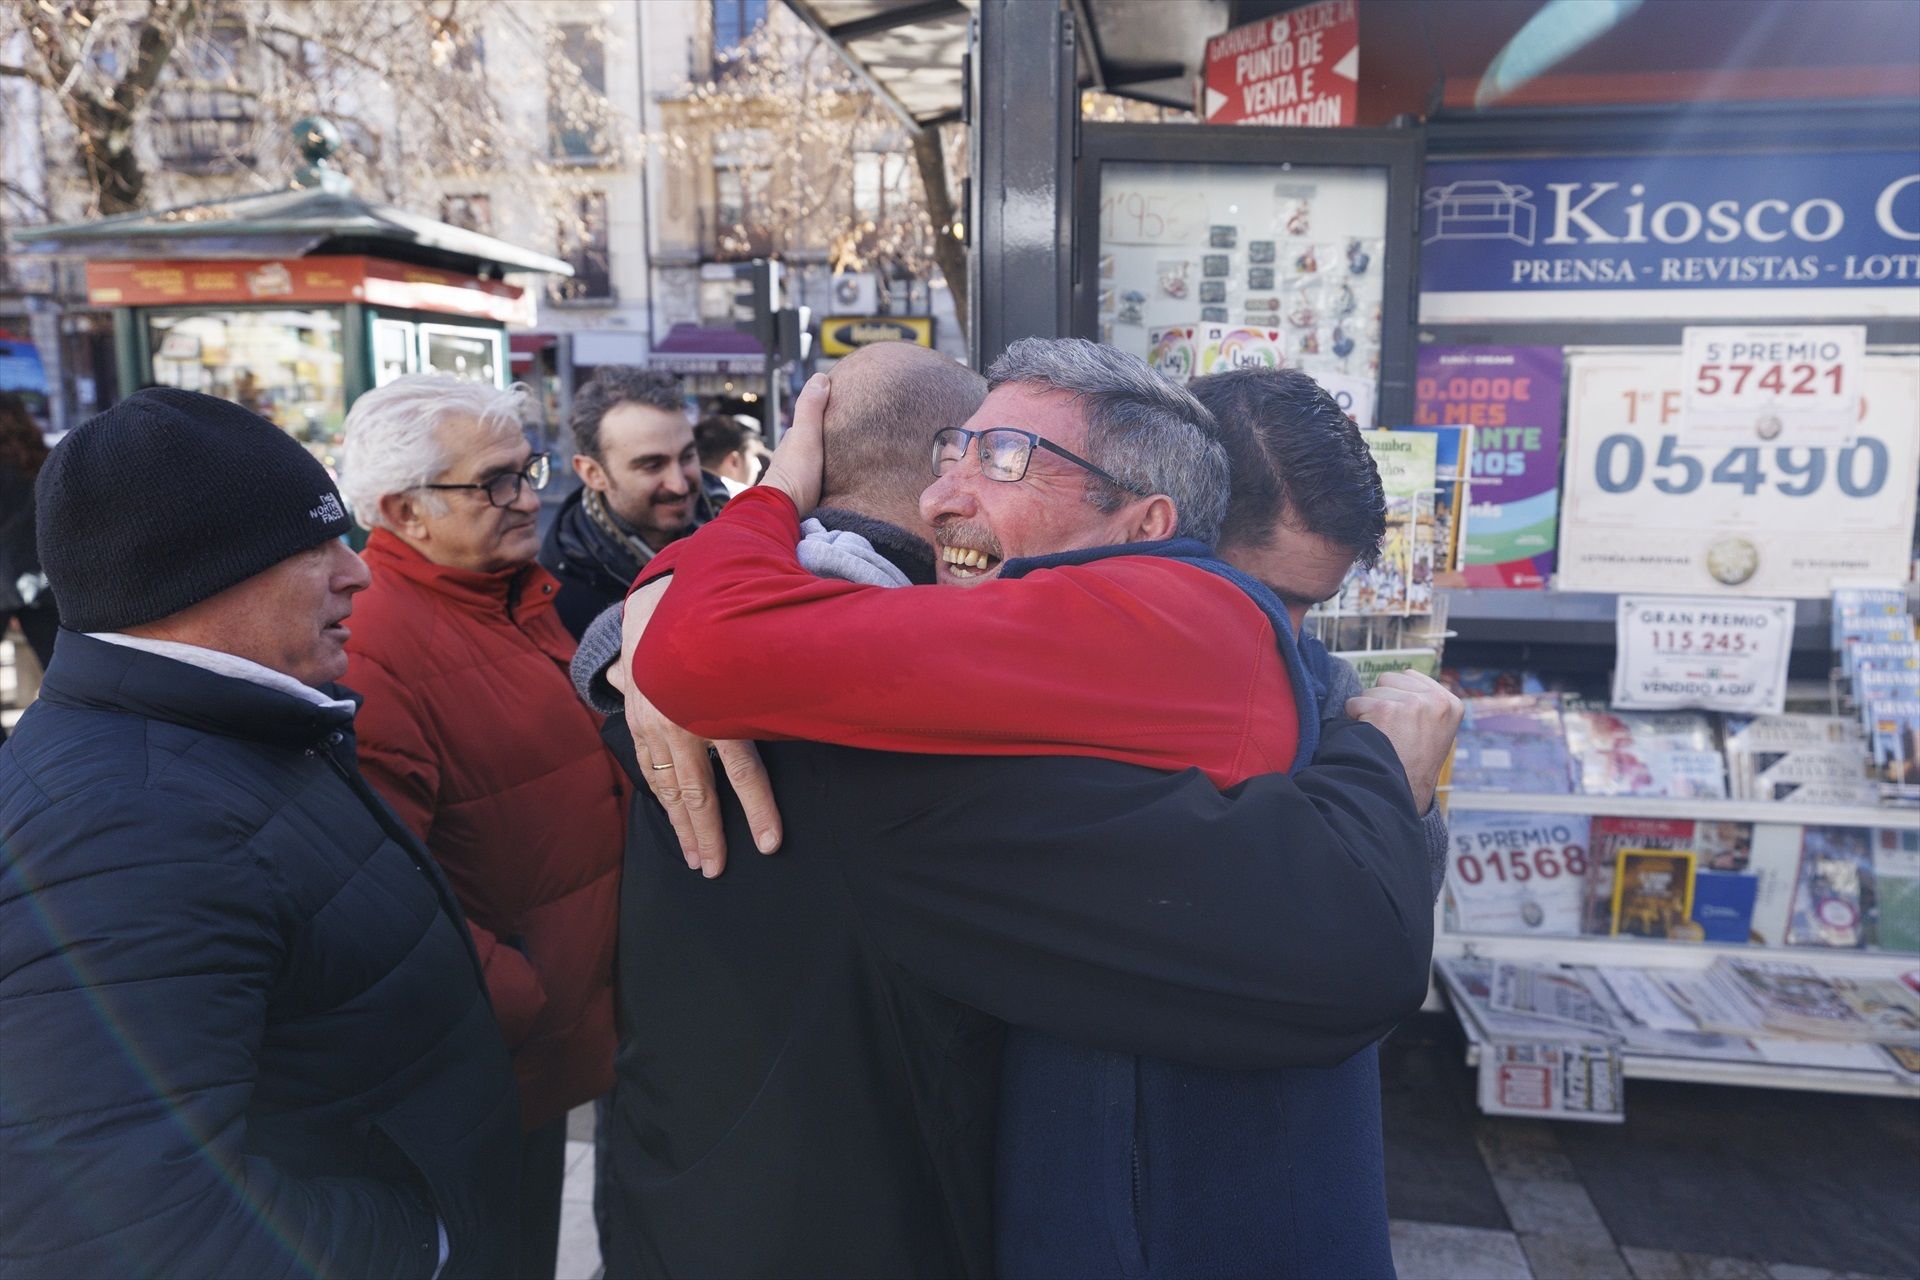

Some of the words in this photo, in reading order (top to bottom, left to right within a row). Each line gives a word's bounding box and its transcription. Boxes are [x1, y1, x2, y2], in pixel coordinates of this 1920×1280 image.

[1236, 41, 1294, 85] PUNTO
[1298, 31, 1323, 68] DE
[1243, 73, 1298, 114] VENTA
[1301, 68, 1315, 100] E
[1236, 92, 1341, 125] MACIÓN
[1543, 182, 1845, 245] Kiosco
[1511, 258, 1636, 284] PRENSA
[1660, 256, 1820, 282] REVISTAS
[1731, 342, 1841, 361] PREMIO
[1697, 364, 1845, 395] 57421
[1444, 403, 1506, 425] MES
[1594, 433, 1889, 498] 05490
[1640, 610, 1693, 624] GRAN
[1700, 613, 1768, 628] PREMIO
[1641, 682, 1712, 696] VENDIDO
[1477, 825, 1572, 850] PREMIO
[1457, 844, 1587, 885] 01568
